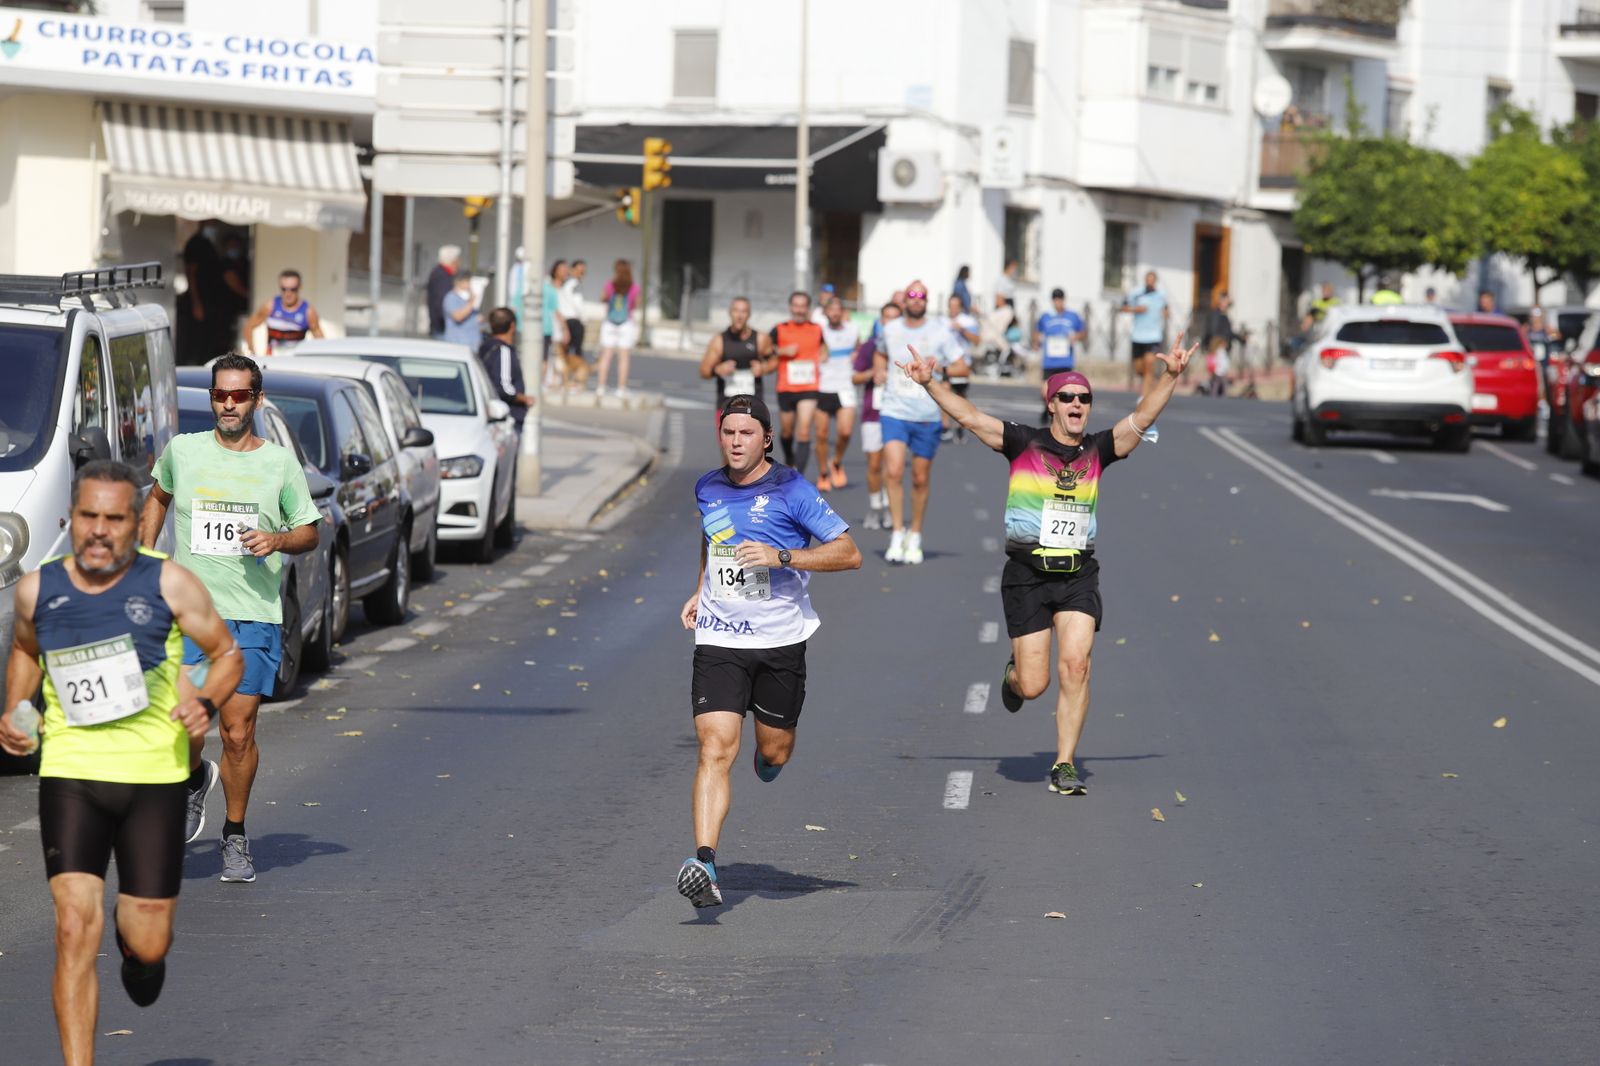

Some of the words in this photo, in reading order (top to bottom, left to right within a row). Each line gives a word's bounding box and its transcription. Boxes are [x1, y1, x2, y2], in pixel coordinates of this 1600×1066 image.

[37, 19, 192, 50] CHURROS
[224, 36, 376, 63] CHOCOLA
[82, 50, 231, 77] PATATAS
[242, 62, 354, 88] FRITAS
[205, 502, 225, 511] VUELTA
[226, 504, 231, 512] A
[232, 504, 254, 513] HUELVA
[203, 521, 235, 541] 116
[1051, 519, 1076, 536] 272
[717, 567, 746, 587] 134
[696, 615, 754, 635] HUELVA
[66, 674, 108, 704] 231
